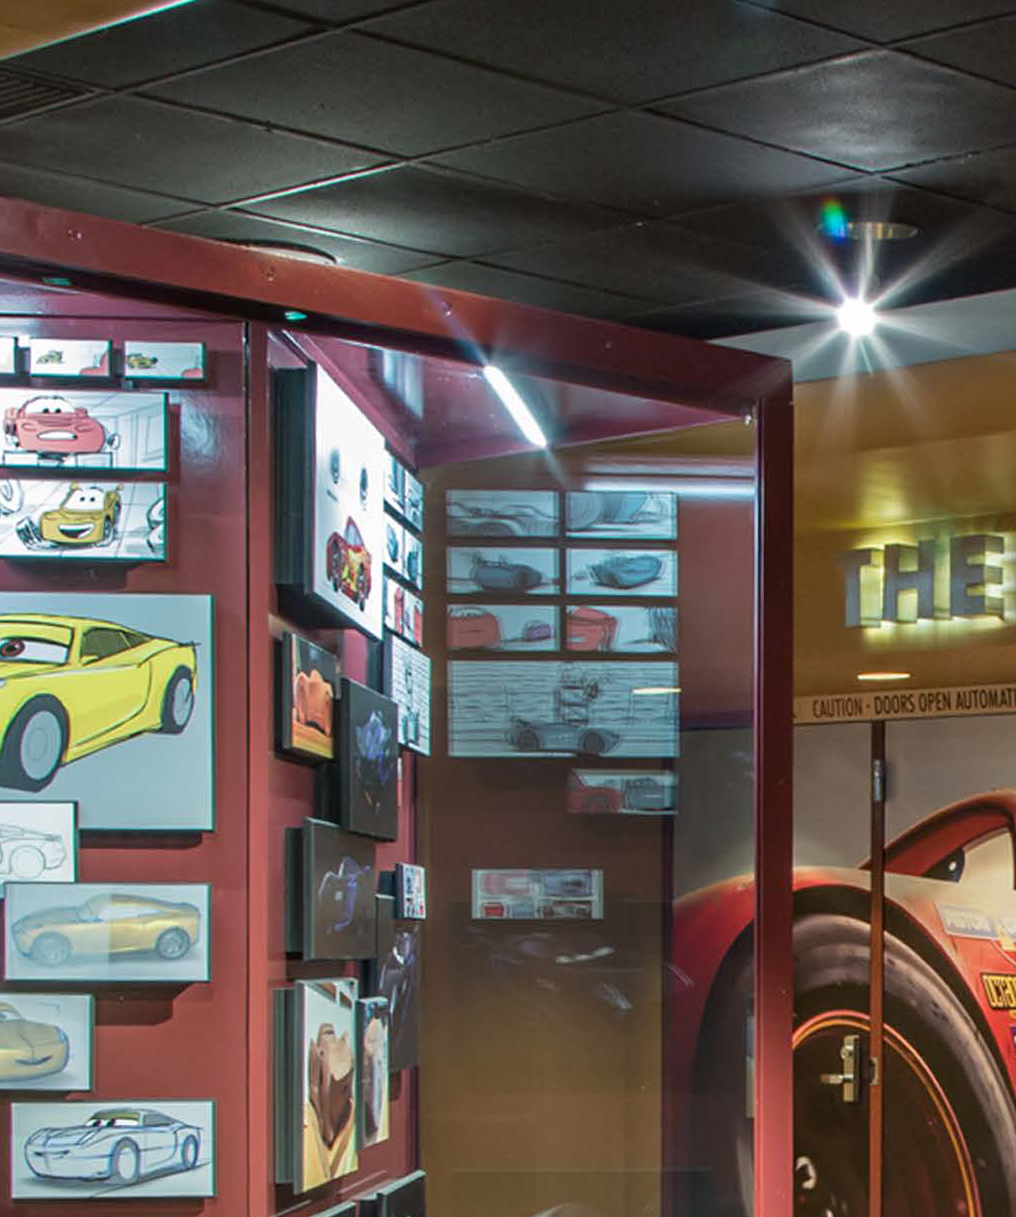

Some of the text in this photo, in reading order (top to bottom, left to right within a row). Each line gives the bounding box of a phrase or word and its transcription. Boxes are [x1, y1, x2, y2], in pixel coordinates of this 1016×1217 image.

[836, 534, 1004, 628] THE
[812, 698, 863, 719] CAUTION
[874, 693, 916, 716] DOORS
[919, 691, 952, 712] OPEN
